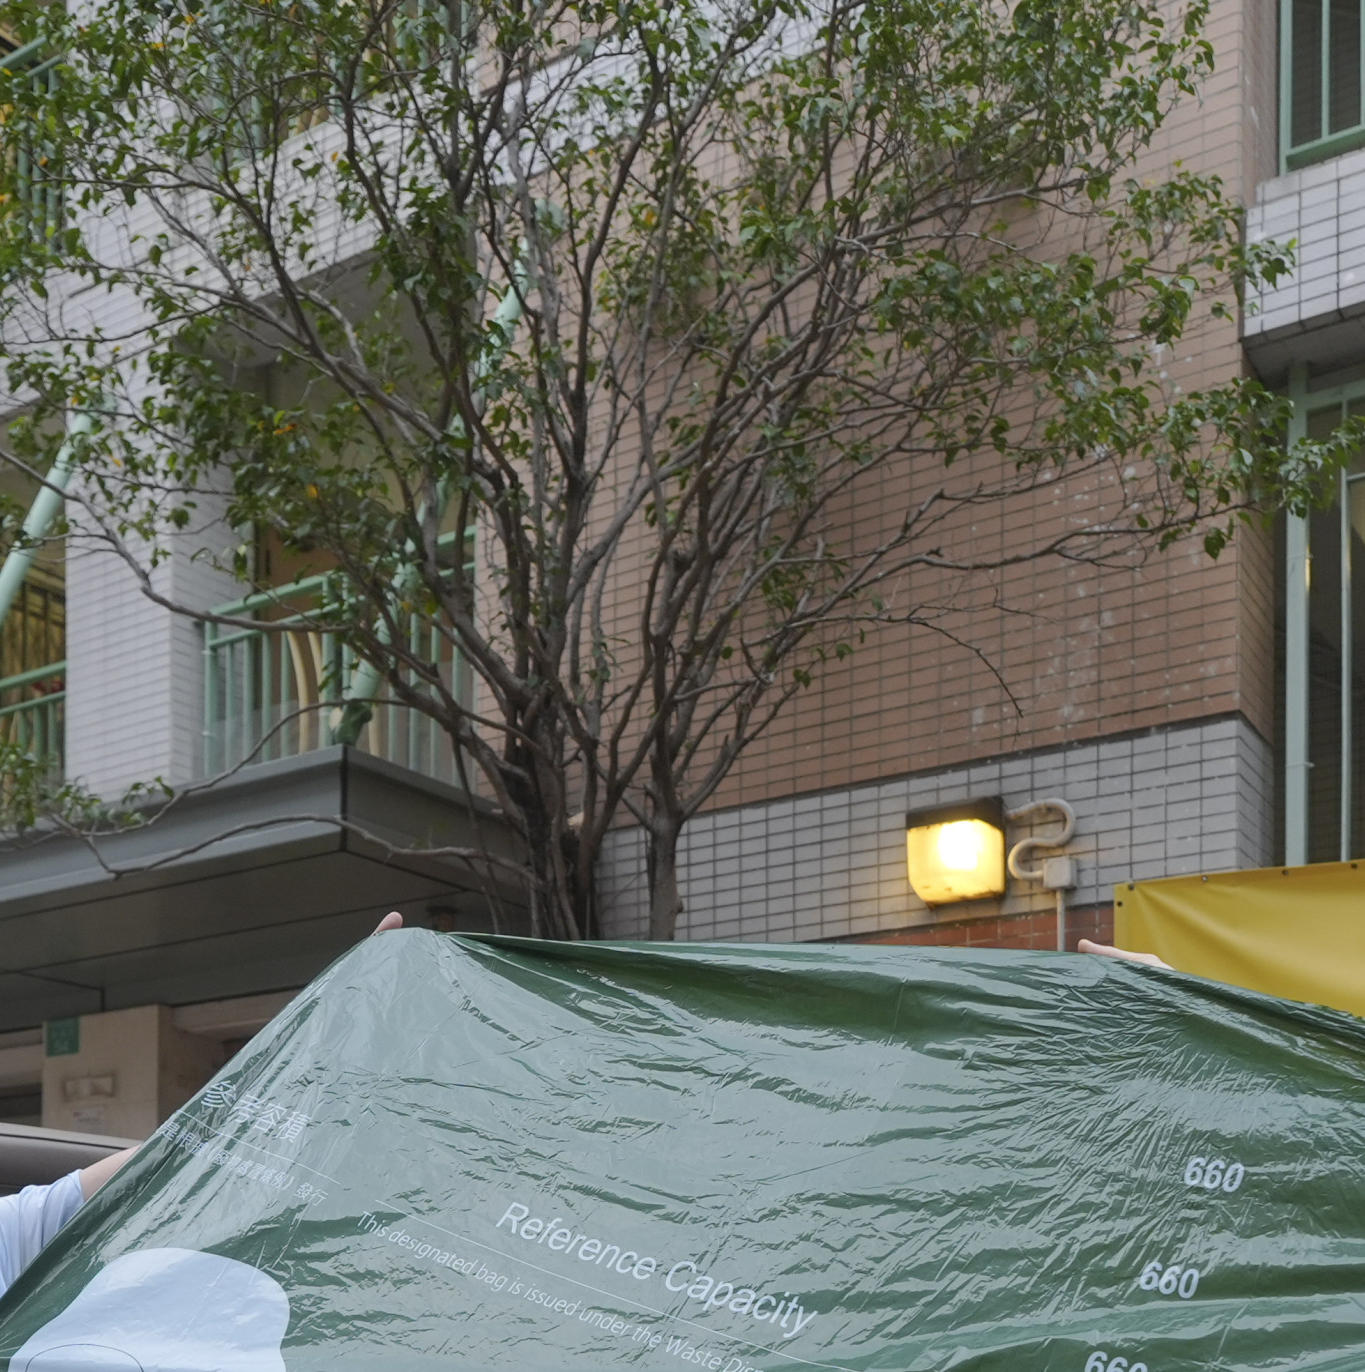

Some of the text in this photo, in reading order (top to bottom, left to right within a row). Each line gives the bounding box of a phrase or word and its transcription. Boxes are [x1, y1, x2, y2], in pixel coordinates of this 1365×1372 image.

[1185, 1157, 1245, 1192] 660
[357, 1211, 389, 1238] This
[389, 1228, 479, 1274] designated
[475, 1266, 508, 1291] bag
[508, 1276, 527, 1295] is
[523, 1283, 581, 1316] issued
[579, 1307, 632, 1338] under
[635, 1322, 662, 1348] the
[665, 1336, 721, 1369] Waste
[496, 1202, 817, 1338] Reference Capacity
[1139, 1261, 1199, 1298] 660
